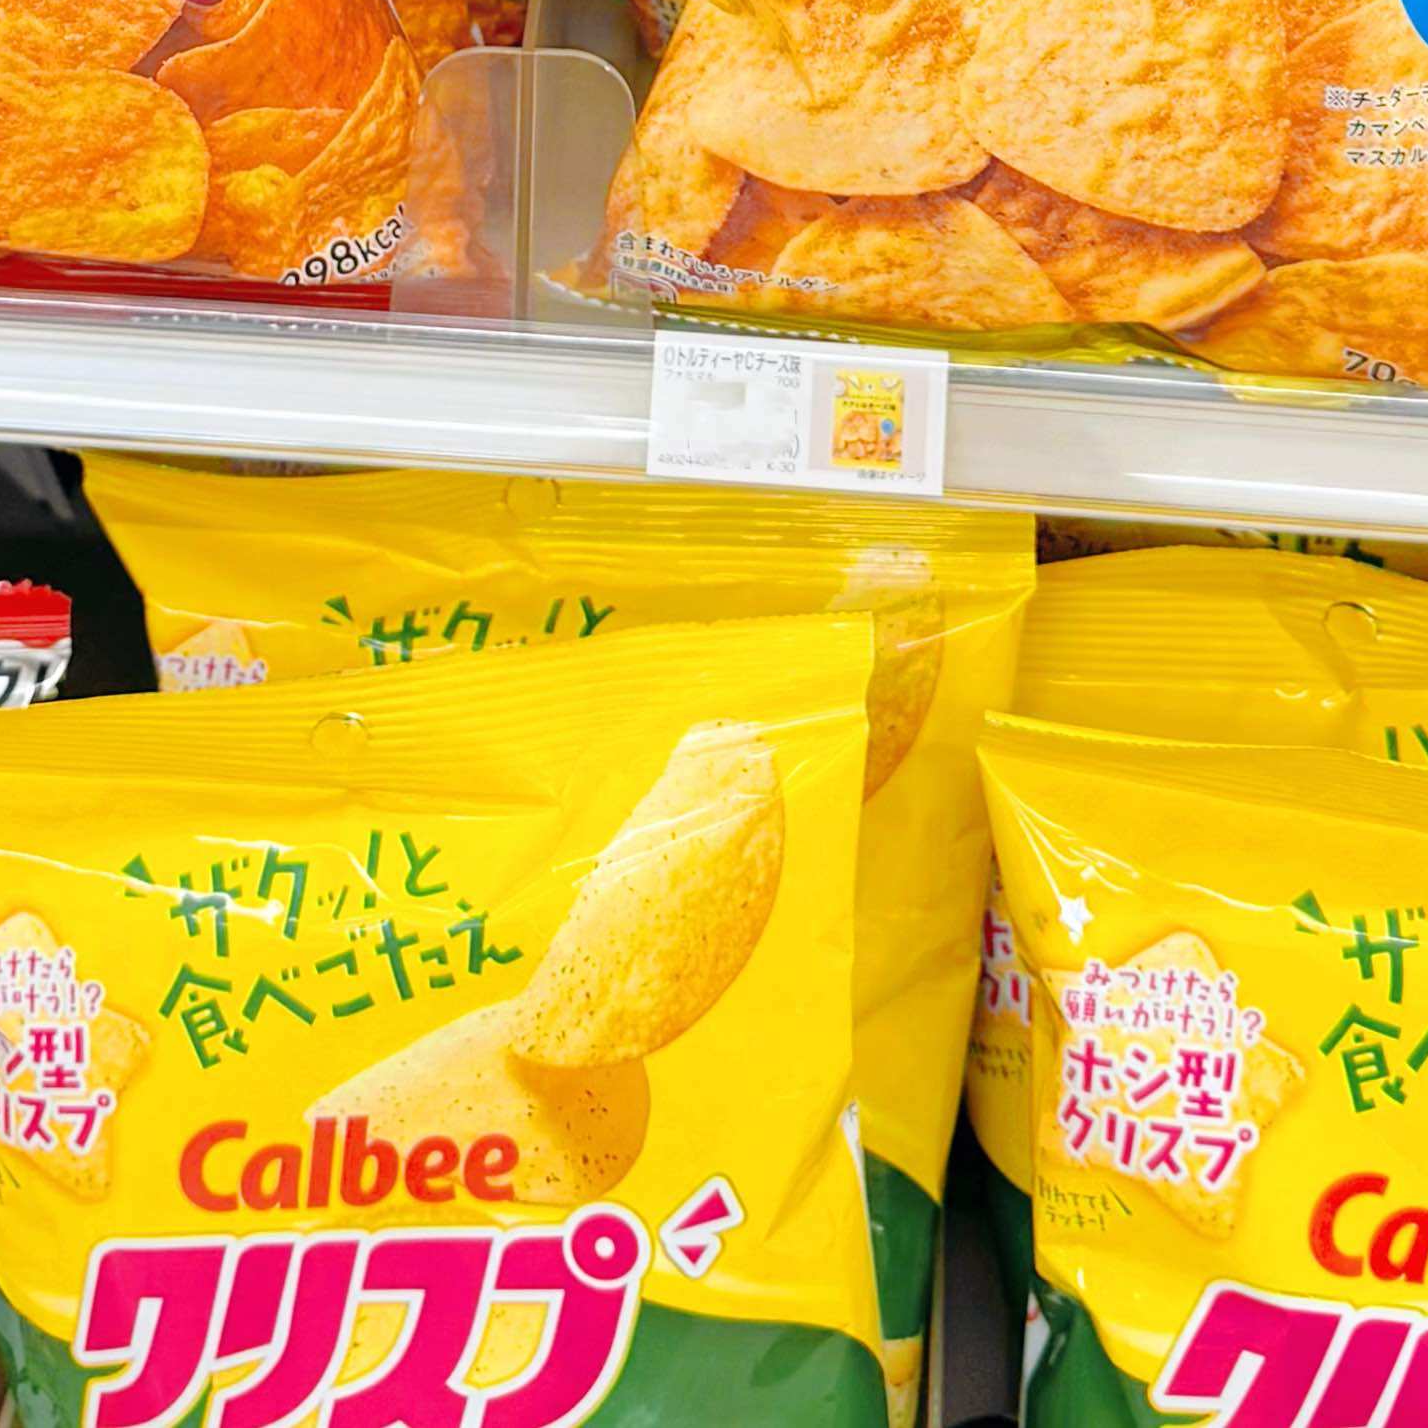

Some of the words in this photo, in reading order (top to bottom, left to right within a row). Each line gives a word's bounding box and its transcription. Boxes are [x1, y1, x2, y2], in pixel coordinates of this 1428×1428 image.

[157, 899, 526, 1070] 食べごたえ
[1085, 962, 1238, 1004] みつけたら
[1066, 1037, 1238, 1120] ホシ型
[177, 1118, 521, 1215] Calbee
[1060, 1095, 1255, 1185] クリスプ
